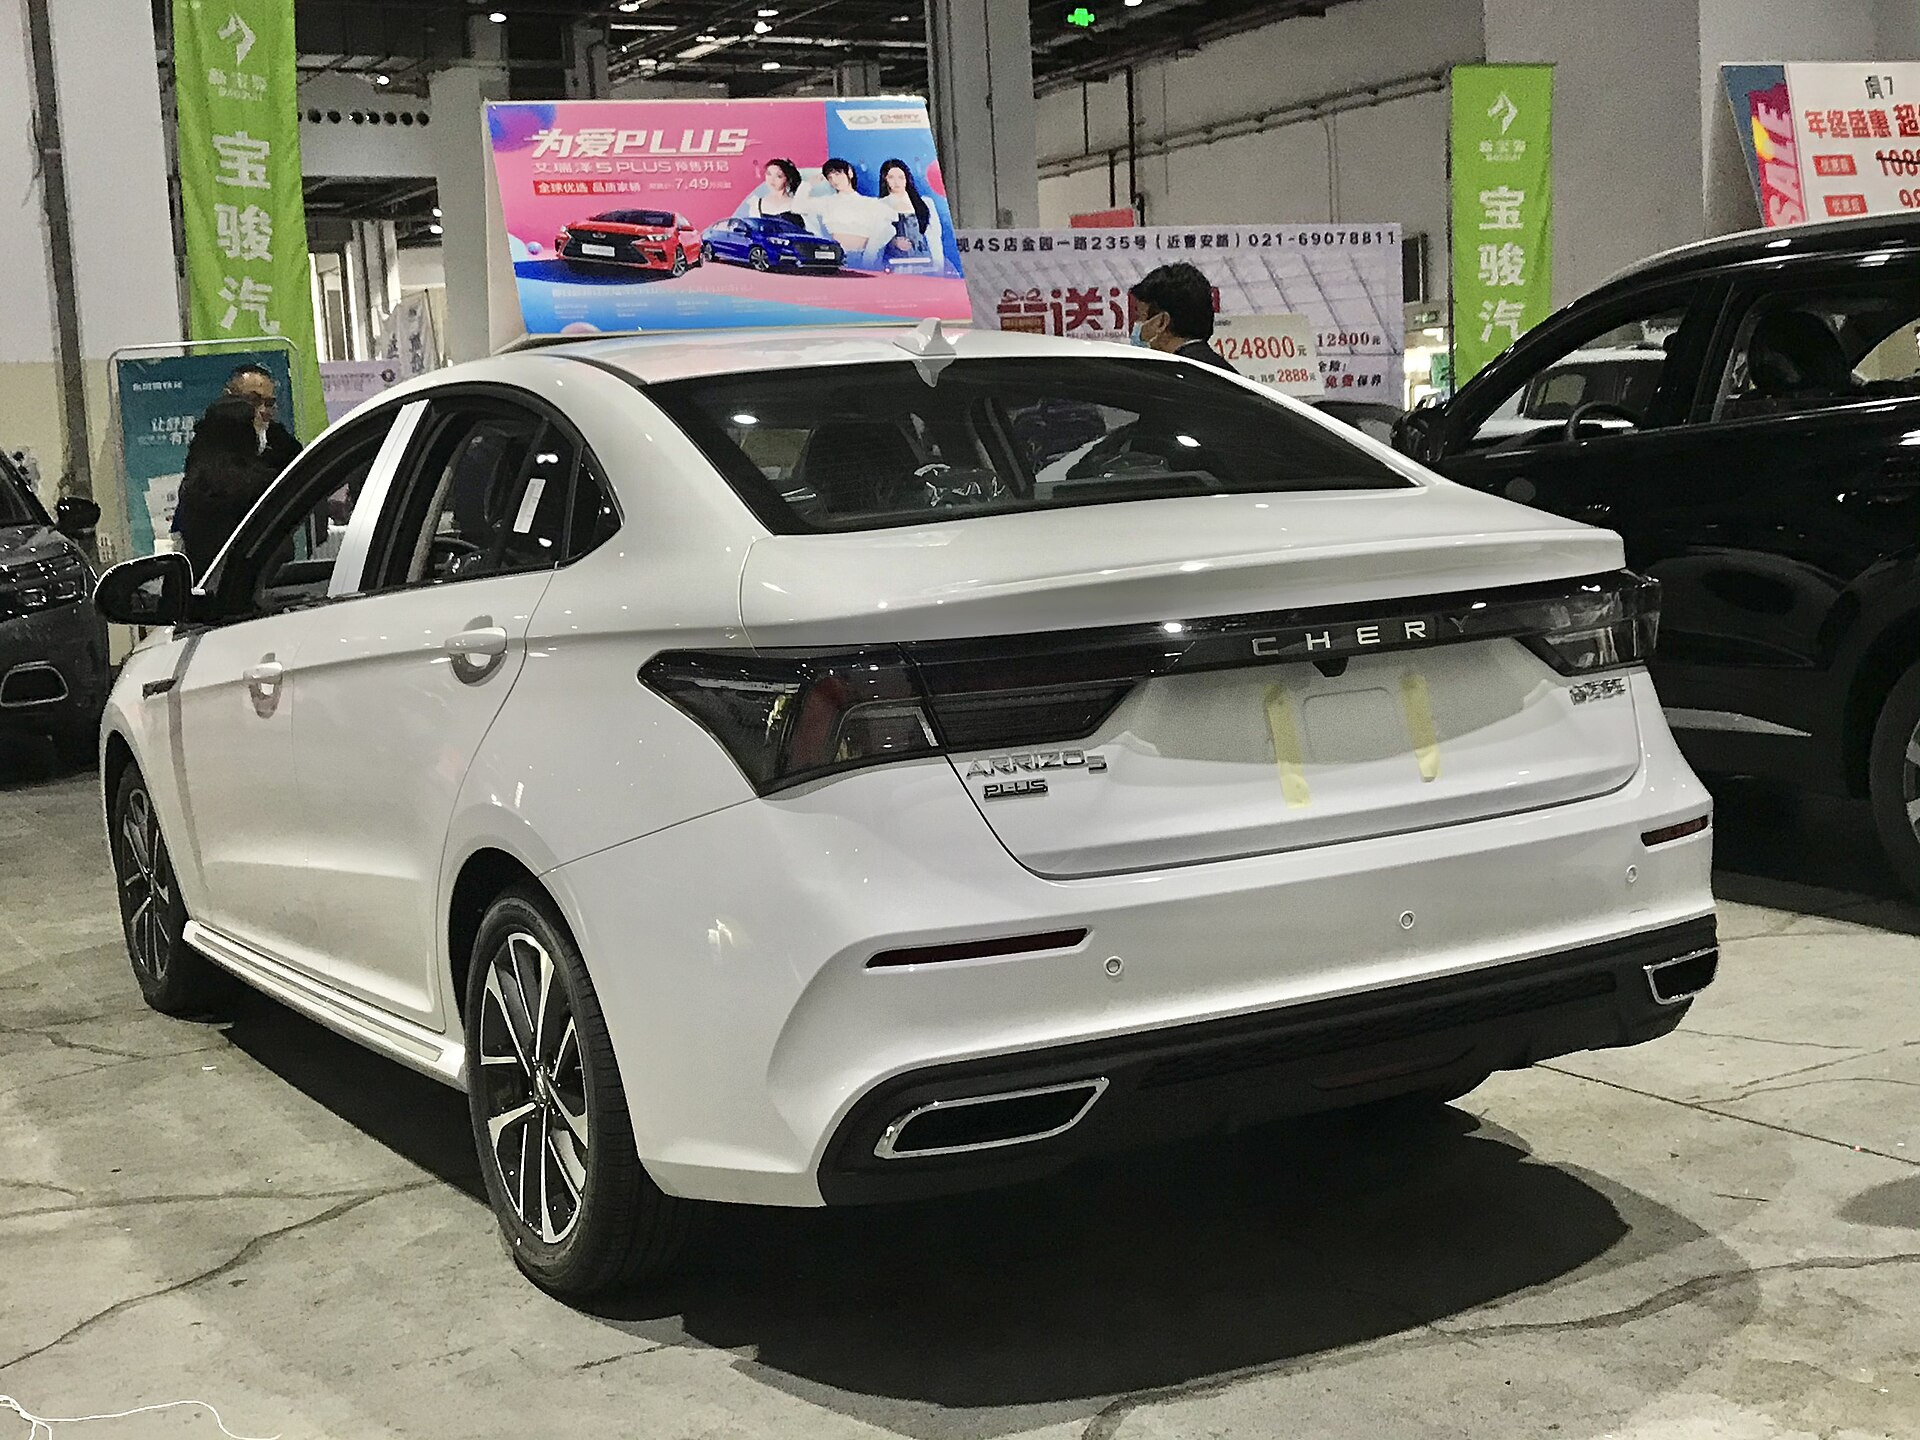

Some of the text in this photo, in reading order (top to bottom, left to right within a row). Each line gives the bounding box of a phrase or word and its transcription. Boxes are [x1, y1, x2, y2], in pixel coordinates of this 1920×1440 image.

[531, 128, 749, 158] 为爱PLUS
[1757, 102, 1804, 228] SALE
[1252, 615, 1469, 656] CHERY
[984, 779, 1049, 802] PLUS
